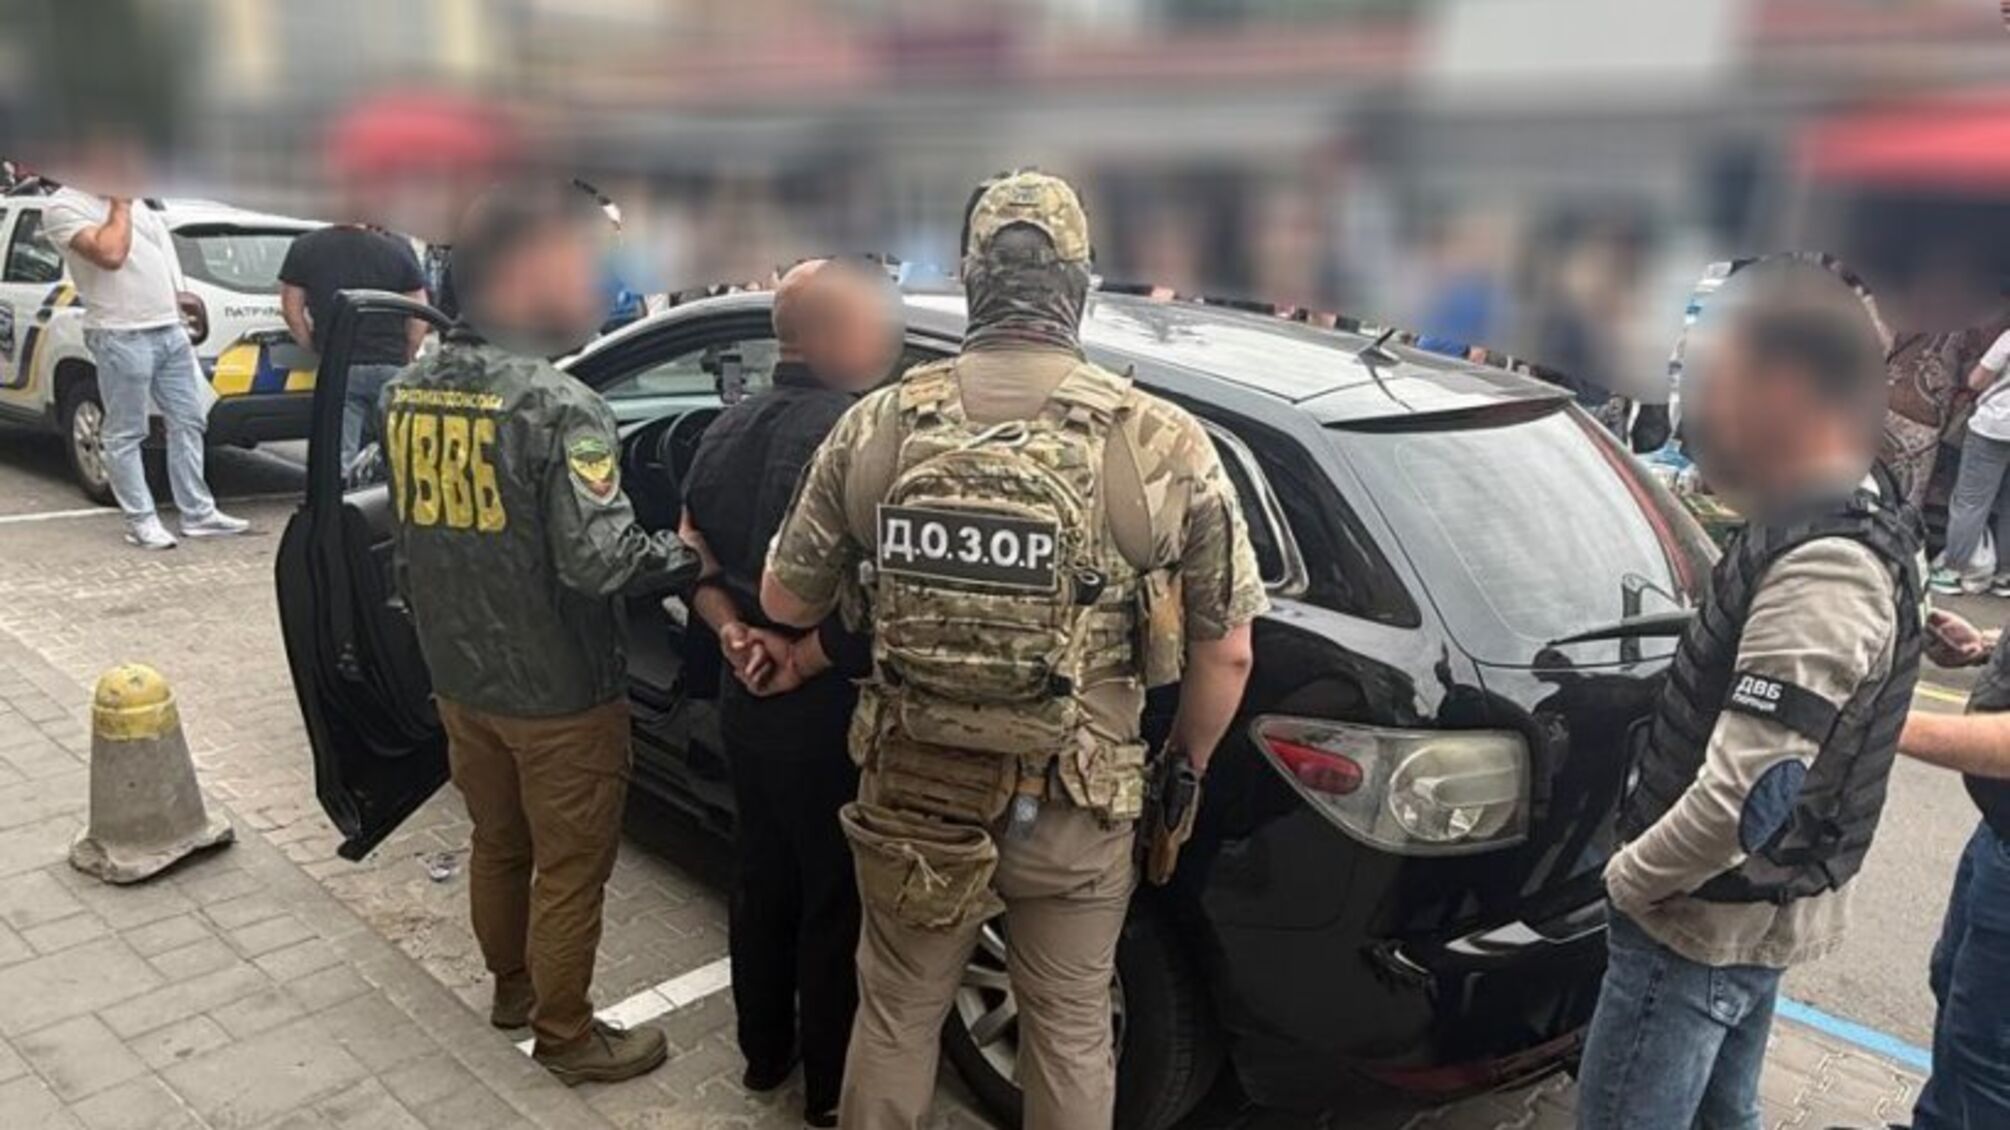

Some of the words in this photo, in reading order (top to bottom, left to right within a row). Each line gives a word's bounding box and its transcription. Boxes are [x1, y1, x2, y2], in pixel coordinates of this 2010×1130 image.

[388, 411, 506, 531] УВВБ
[883, 518, 1053, 569] Д.О.З.О.Р.
[1735, 675, 1782, 700] ДВБ
